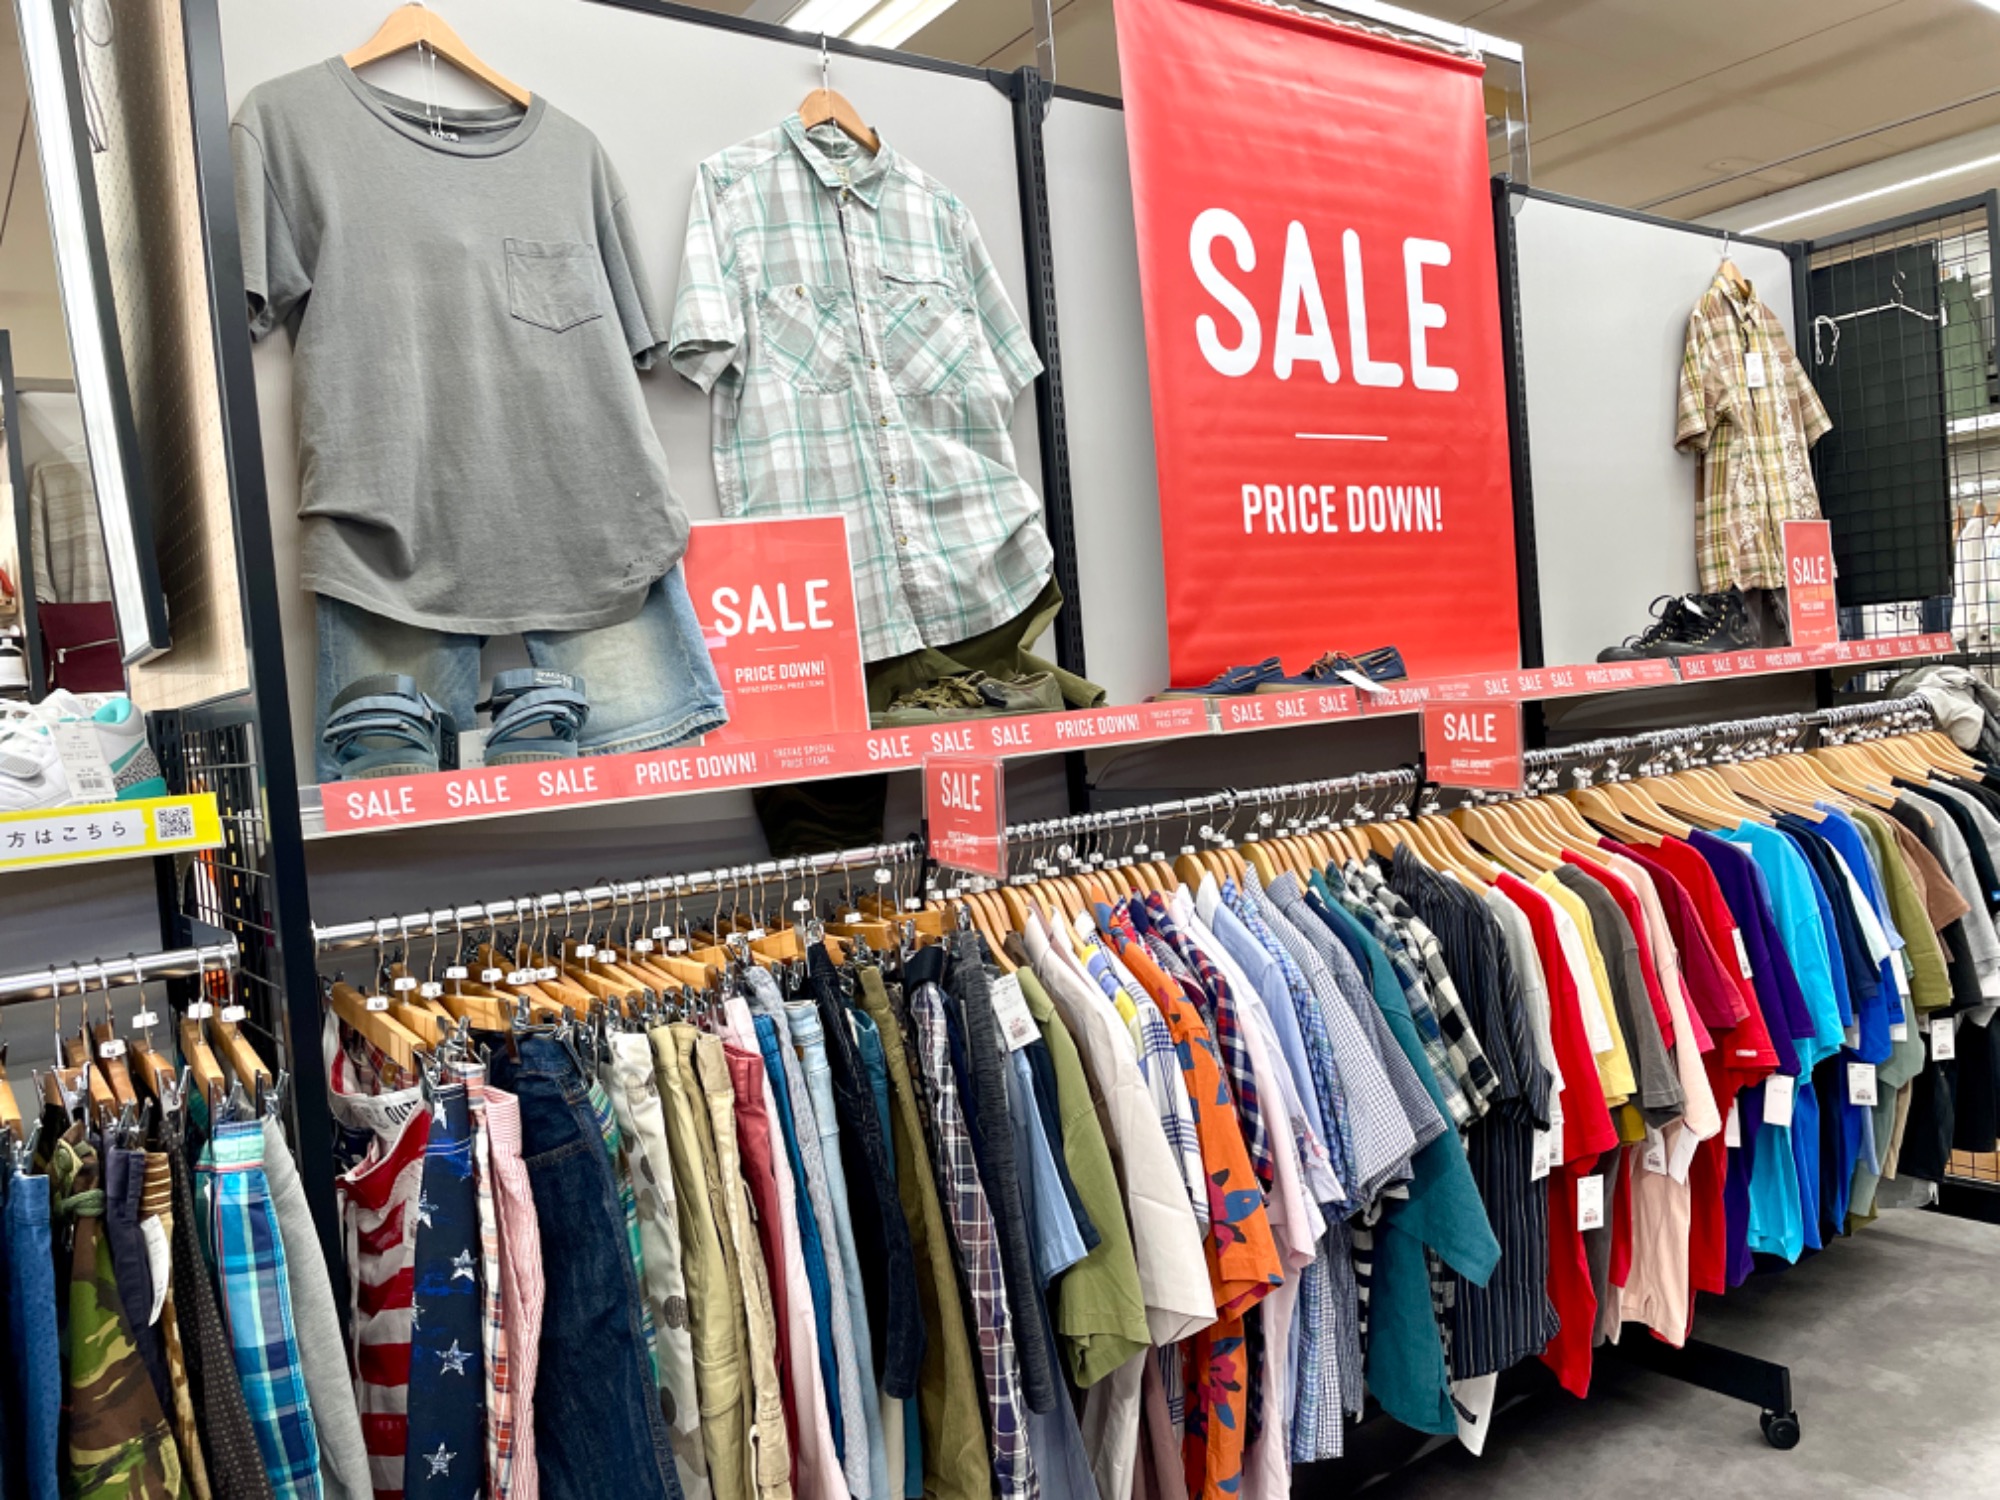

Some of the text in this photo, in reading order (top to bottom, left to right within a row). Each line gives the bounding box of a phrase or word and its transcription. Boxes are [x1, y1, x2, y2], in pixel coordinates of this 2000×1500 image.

[1189, 207, 1459, 392] SALE
[1241, 483, 1443, 534] PRICE DOWN!
[1793, 555, 1828, 585] SALE
[712, 579, 834, 637] SALE
[735, 660, 826, 683] PRICE DOWN!
[1585, 669, 1609, 684] PRICE
[1686, 654, 1756, 675] SALE SALE SALE
[1484, 678, 1511, 696] SALE
[1518, 674, 1543, 691] SALE
[1551, 670, 1575, 688] SALE
[1231, 693, 1349, 724] SALE SALE SALE
[1055, 714, 1140, 739] PRICE DOWN!
[1443, 713, 1497, 743] SALE
[867, 723, 1032, 761] SALE SALE SALE
[635, 751, 758, 786] PRICE DOWN!
[781, 757, 804, 769] PRICE
[347, 766, 599, 820] SALE SALE SALE
[941, 770, 982, 812] SALE
[6, 821, 126, 848] 方はこちら
